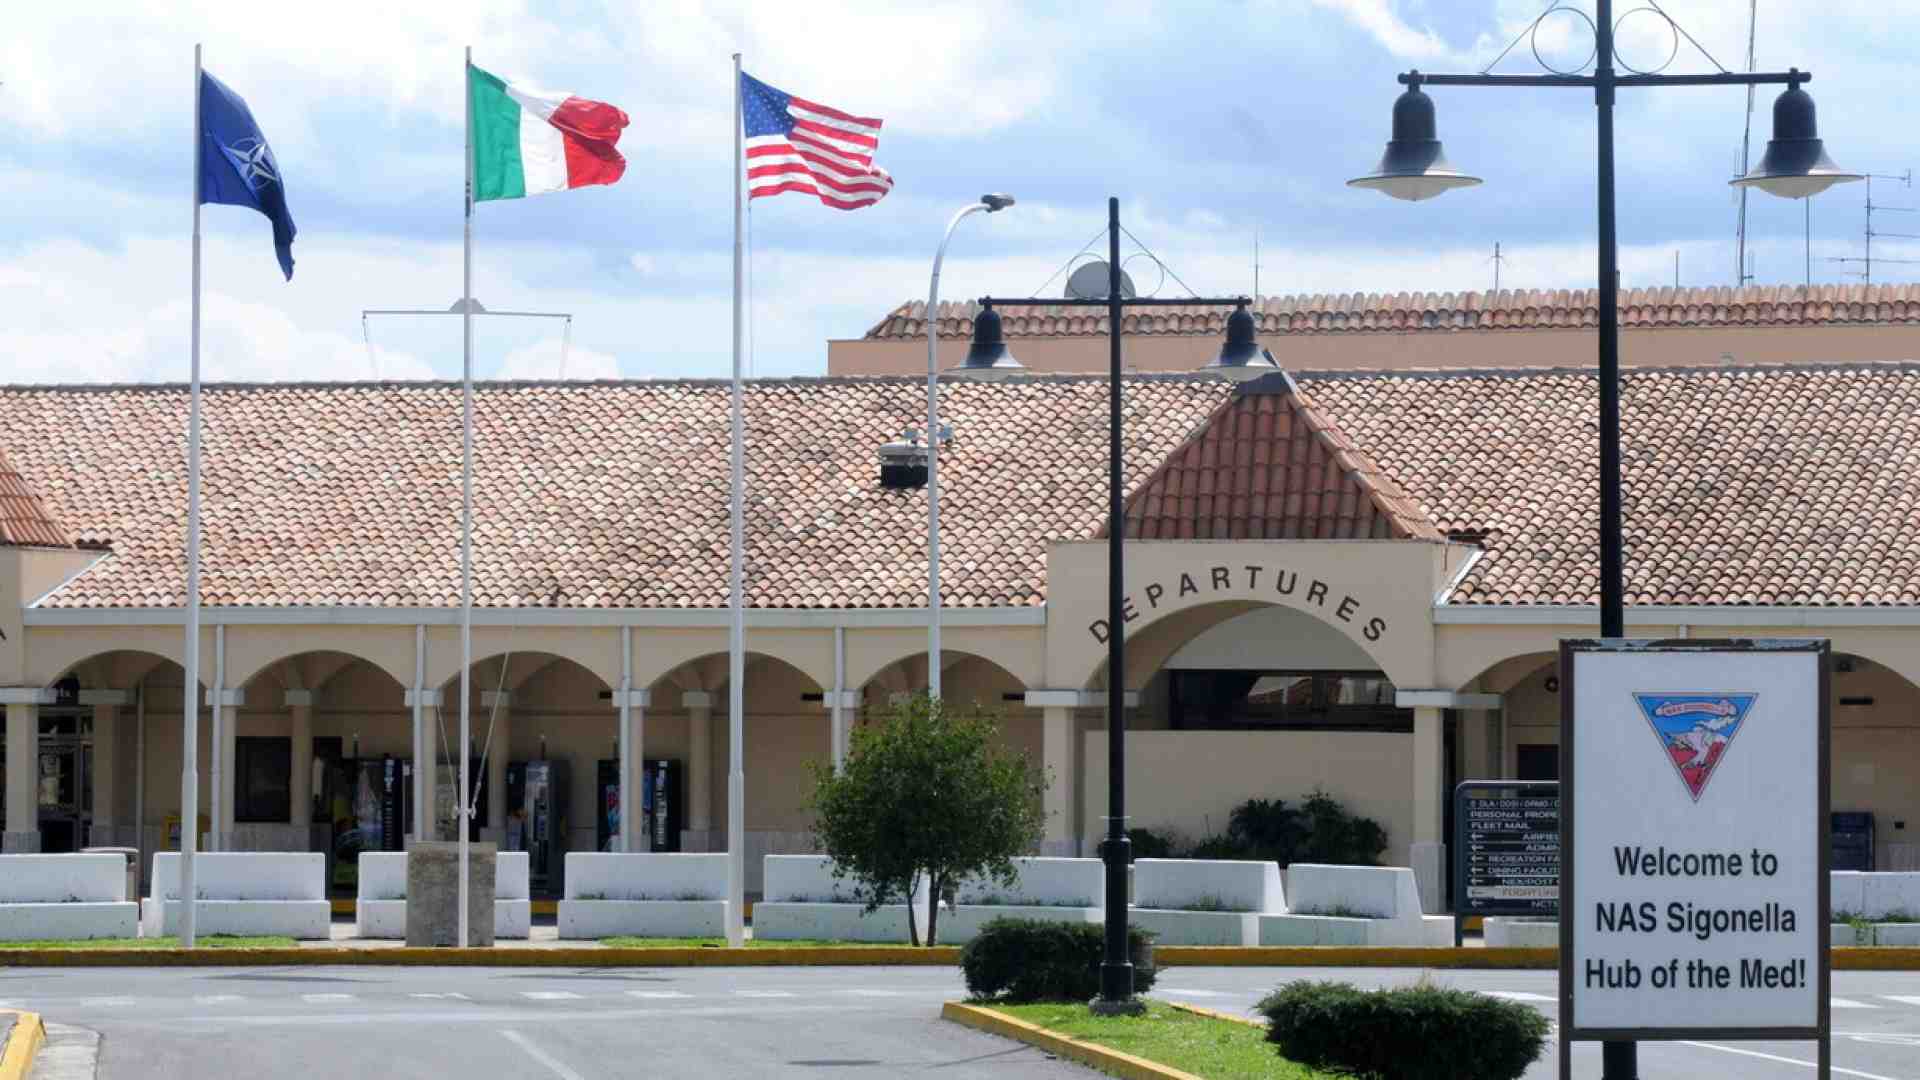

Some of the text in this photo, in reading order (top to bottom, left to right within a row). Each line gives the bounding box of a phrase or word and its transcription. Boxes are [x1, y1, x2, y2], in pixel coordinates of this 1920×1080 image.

[1089, 566, 1386, 644] DEPARTURES
[1471, 810, 1522, 818] PERSONAL
[1471, 821, 1531, 830] FLEET MAIL
[1488, 856, 1545, 864] RECREATION
[1614, 847, 1778, 877] Welcome to
[1488, 866, 1521, 875] DINING
[1596, 901, 1796, 941] NAS Sigonella
[1585, 958, 1806, 989] Hub of the Med!
